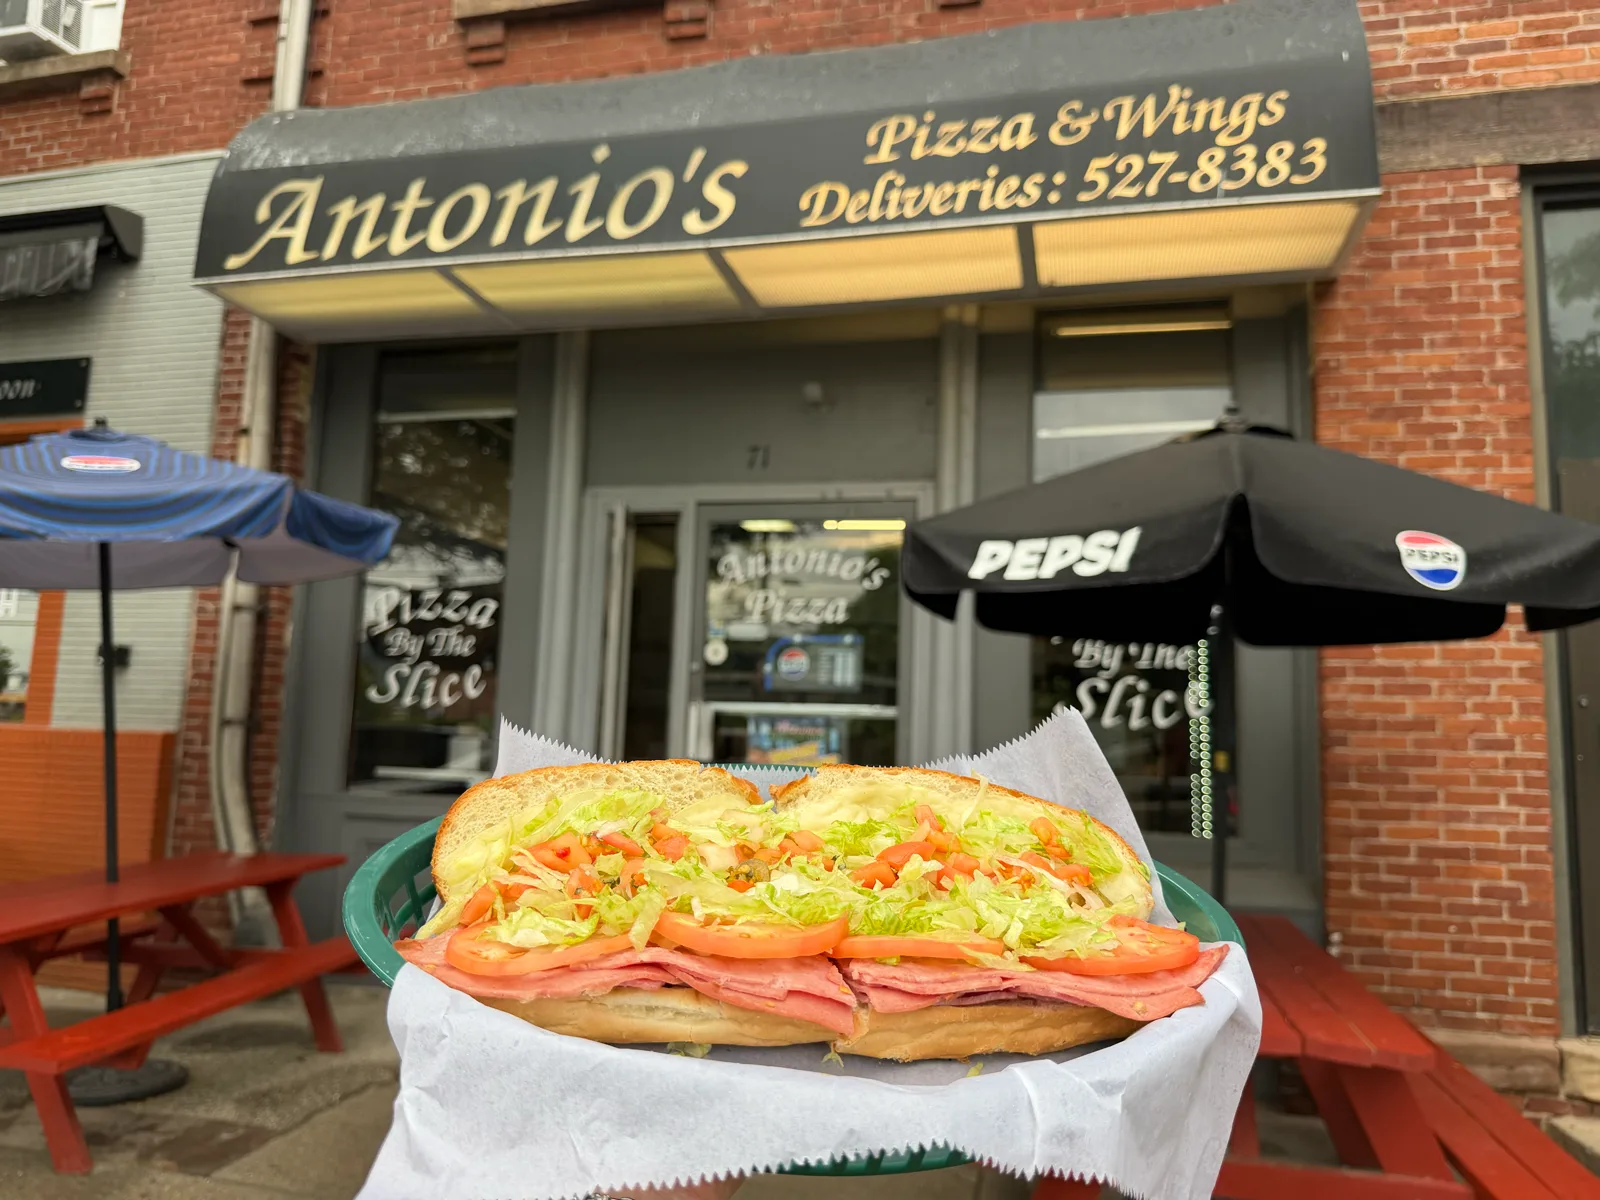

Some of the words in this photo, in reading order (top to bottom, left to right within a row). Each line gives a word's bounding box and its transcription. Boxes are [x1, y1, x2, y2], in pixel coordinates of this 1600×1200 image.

[863, 110, 1038, 165] Pizza
[1048, 99, 1100, 146] &
[1102, 83, 1290, 147] Wings
[223, 143, 750, 271] Antonio's
[798, 163, 1068, 228] Deliveries:
[1076, 137, 1328, 202] 527-8383
[747, 444, 770, 471] 71
[717, 543, 891, 591] Antonio's
[967, 525, 1142, 581] PEPSI
[366, 585, 500, 637] Pizza
[743, 587, 850, 625] Pizza
[384, 626, 425, 666] By
[426, 624, 478, 658] The
[1072, 638, 1128, 680] By
[365, 660, 488, 710] Slice
